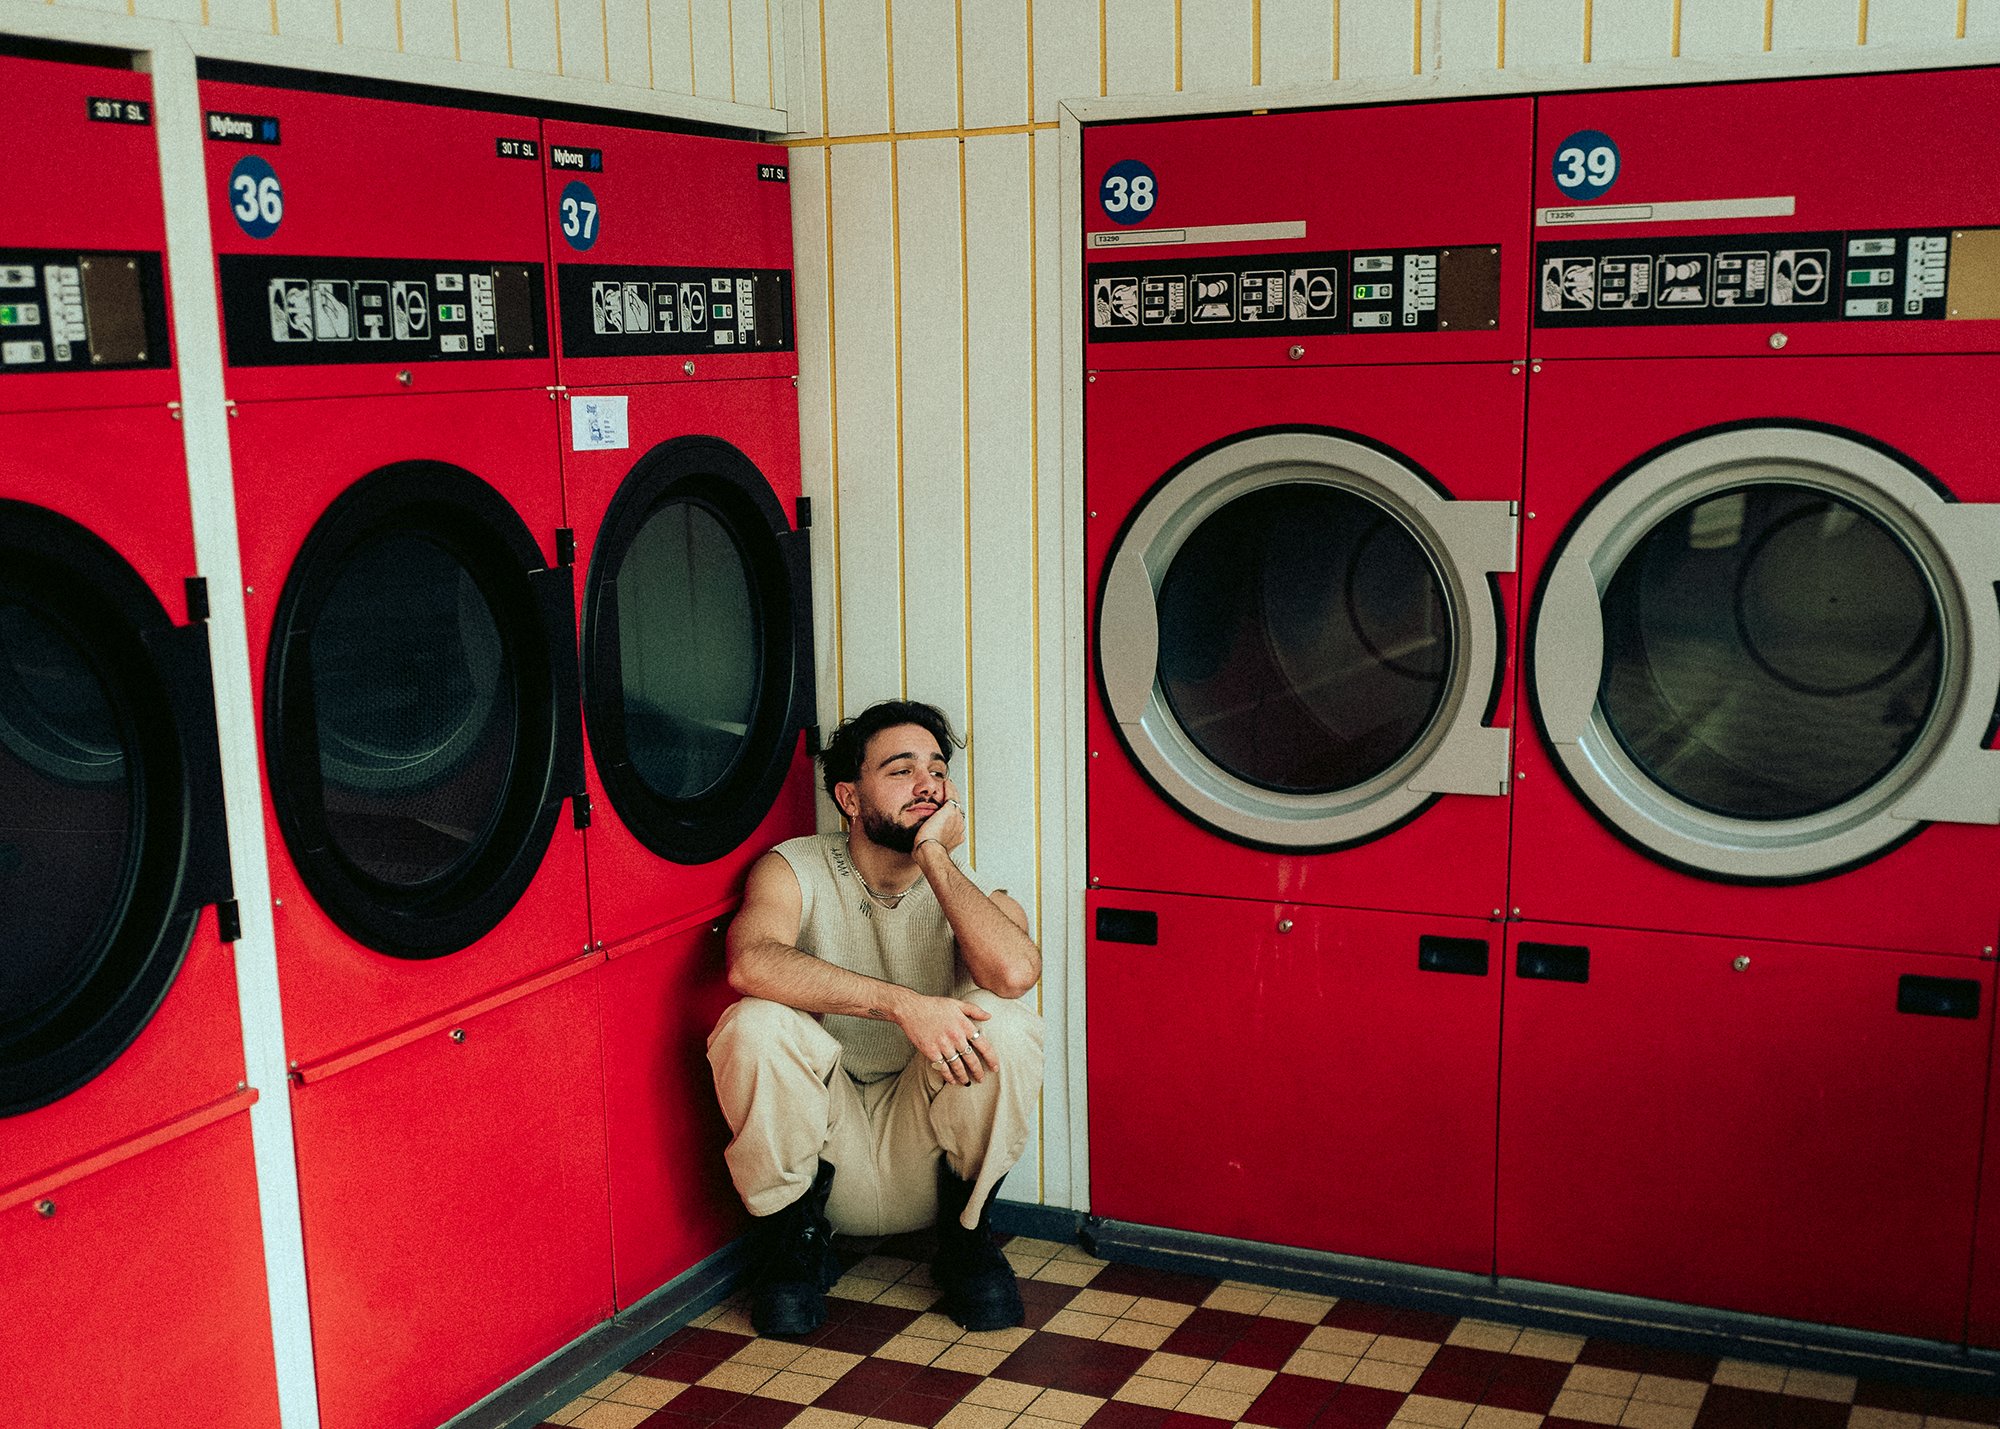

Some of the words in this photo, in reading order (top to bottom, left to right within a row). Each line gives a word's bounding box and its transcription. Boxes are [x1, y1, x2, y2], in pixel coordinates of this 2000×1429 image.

[126, 104, 145, 121] SL
[209, 115, 253, 139] Nyborg
[523, 143, 535, 156] SL
[553, 148, 584, 168] Nyborg
[777, 168, 786, 179] SL
[1557, 146, 1616, 188] 39
[234, 174, 283, 224] 36
[1104, 175, 1154, 212] 38
[562, 197, 597, 239] 37
[1099, 235, 1120, 243] T3290
